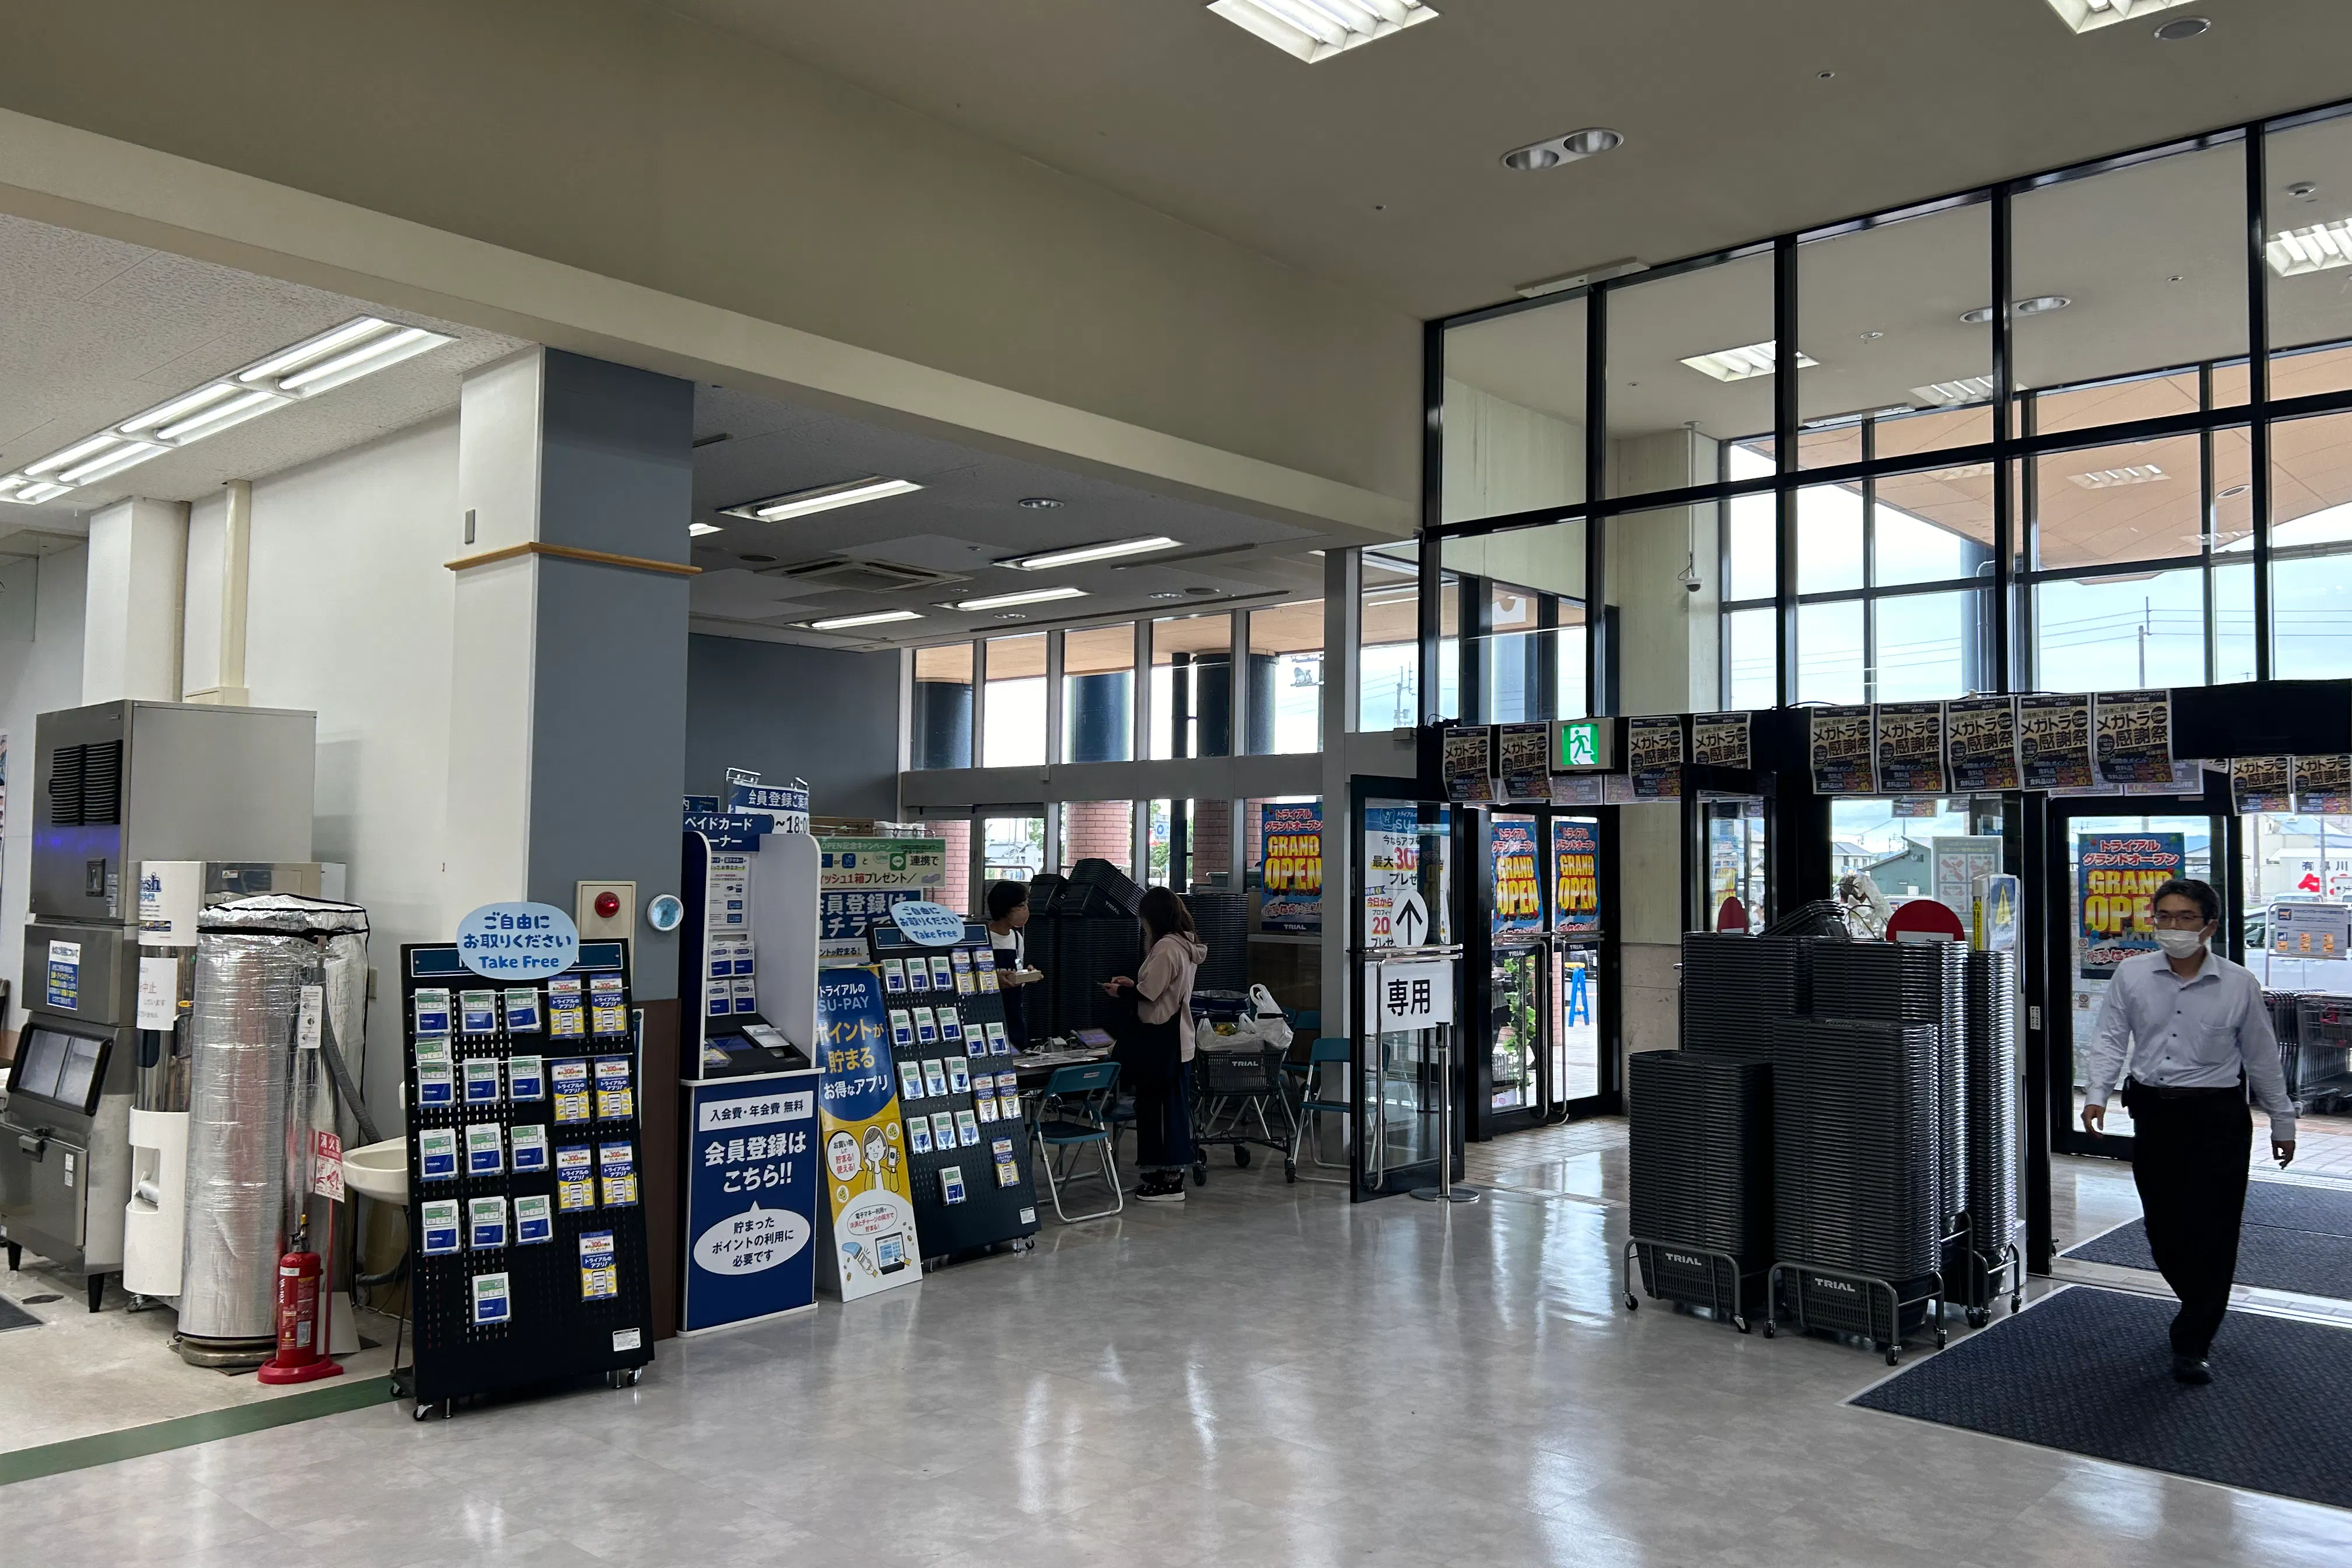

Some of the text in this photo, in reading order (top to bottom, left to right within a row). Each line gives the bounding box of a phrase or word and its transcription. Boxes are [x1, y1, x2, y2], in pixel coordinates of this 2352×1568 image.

[1950, 717, 1997, 738] メガトラ
[2021, 715, 2071, 736] メガトラ
[2097, 710, 2151, 732] メガトラ
[1696, 730, 1735, 748] メガトラ
[1814, 724, 1856, 743] メガトラ
[1880, 722, 1925, 740] メガトラ
[2039, 729, 2088, 750] 感謝祭
[2116, 725, 2168, 747] 感謝祭
[1445, 743, 1477, 758] メガトラ
[1502, 740, 1536, 756] メガトラ
[1631, 733, 1669, 751] メガトラ
[2234, 760, 2274, 775] メガトラ
[2295, 758, 2337, 773] メガトラ
[1275, 808, 1312, 820] トライアル
[685, 816, 753, 831] ペイドカード
[1264, 820, 1323, 832] グランドオープン
[1499, 827, 1527, 841] トライアル
[1563, 827, 1589, 839] トライアル
[1268, 835, 1320, 857] GRAND
[1492, 840, 1535, 852] グランドオープン
[1556, 840, 1596, 851] グランドオープン
[2099, 839, 2161, 852] トライアル
[909, 855, 939, 866] 連携で
[1373, 847, 1419, 870] 最大30
[1559, 855, 1595, 876] GRAND
[2082, 853, 2180, 866] グランドオープン
[1265, 858, 1322, 890] OPEN
[1496, 856, 1535, 879] GRAND
[1367, 897, 1393, 907] 今日から
[1496, 879, 1539, 915] OPEN
[1558, 877, 1598, 911] OPEN
[902, 906, 941, 915] ご自由に
[484, 912, 550, 930] ご自由に
[898, 916, 958, 927] お取りください
[1373, 916, 1390, 935] 20
[463, 933, 572, 949] お取りください
[912, 930, 936, 940] Take
[937, 929, 958, 938] Free
[479, 956, 519, 969] Take
[523, 955, 560, 968] Free
[818, 983, 866, 998] トライアルの
[1387, 978, 1430, 1016] 専用
[818, 996, 869, 1013] SU-PAY
[816, 1018, 885, 1045] ポイントが
[828, 1046, 875, 1073] 貯まる
[823, 1074, 888, 1100] お得なアプリ
[710, 1100, 804, 1122] 入会費・年会費 無料
[320, 1133, 341, 1153] 消火器
[704, 1131, 806, 1167] 会員登録は
[833, 1139, 854, 1149] お買い物
[835, 1153, 855, 1164] 貯まる!
[836, 1163, 855, 1174] 使える!
[723, 1161, 792, 1194] こちら!!
[855, 1207, 887, 1219] 電子マネー利用で
[733, 1216, 775, 1234] 貯まった
[865, 1223, 880, 1233] 貯まる!
[712, 1229, 794, 1255] ポイントの利用に
[585, 1256, 612, 1264] トライアルの
[732, 1249, 774, 1268] 必要です
[1665, 1252, 1702, 1266] TRIAL
[1814, 1278, 1856, 1293] TRIAL
